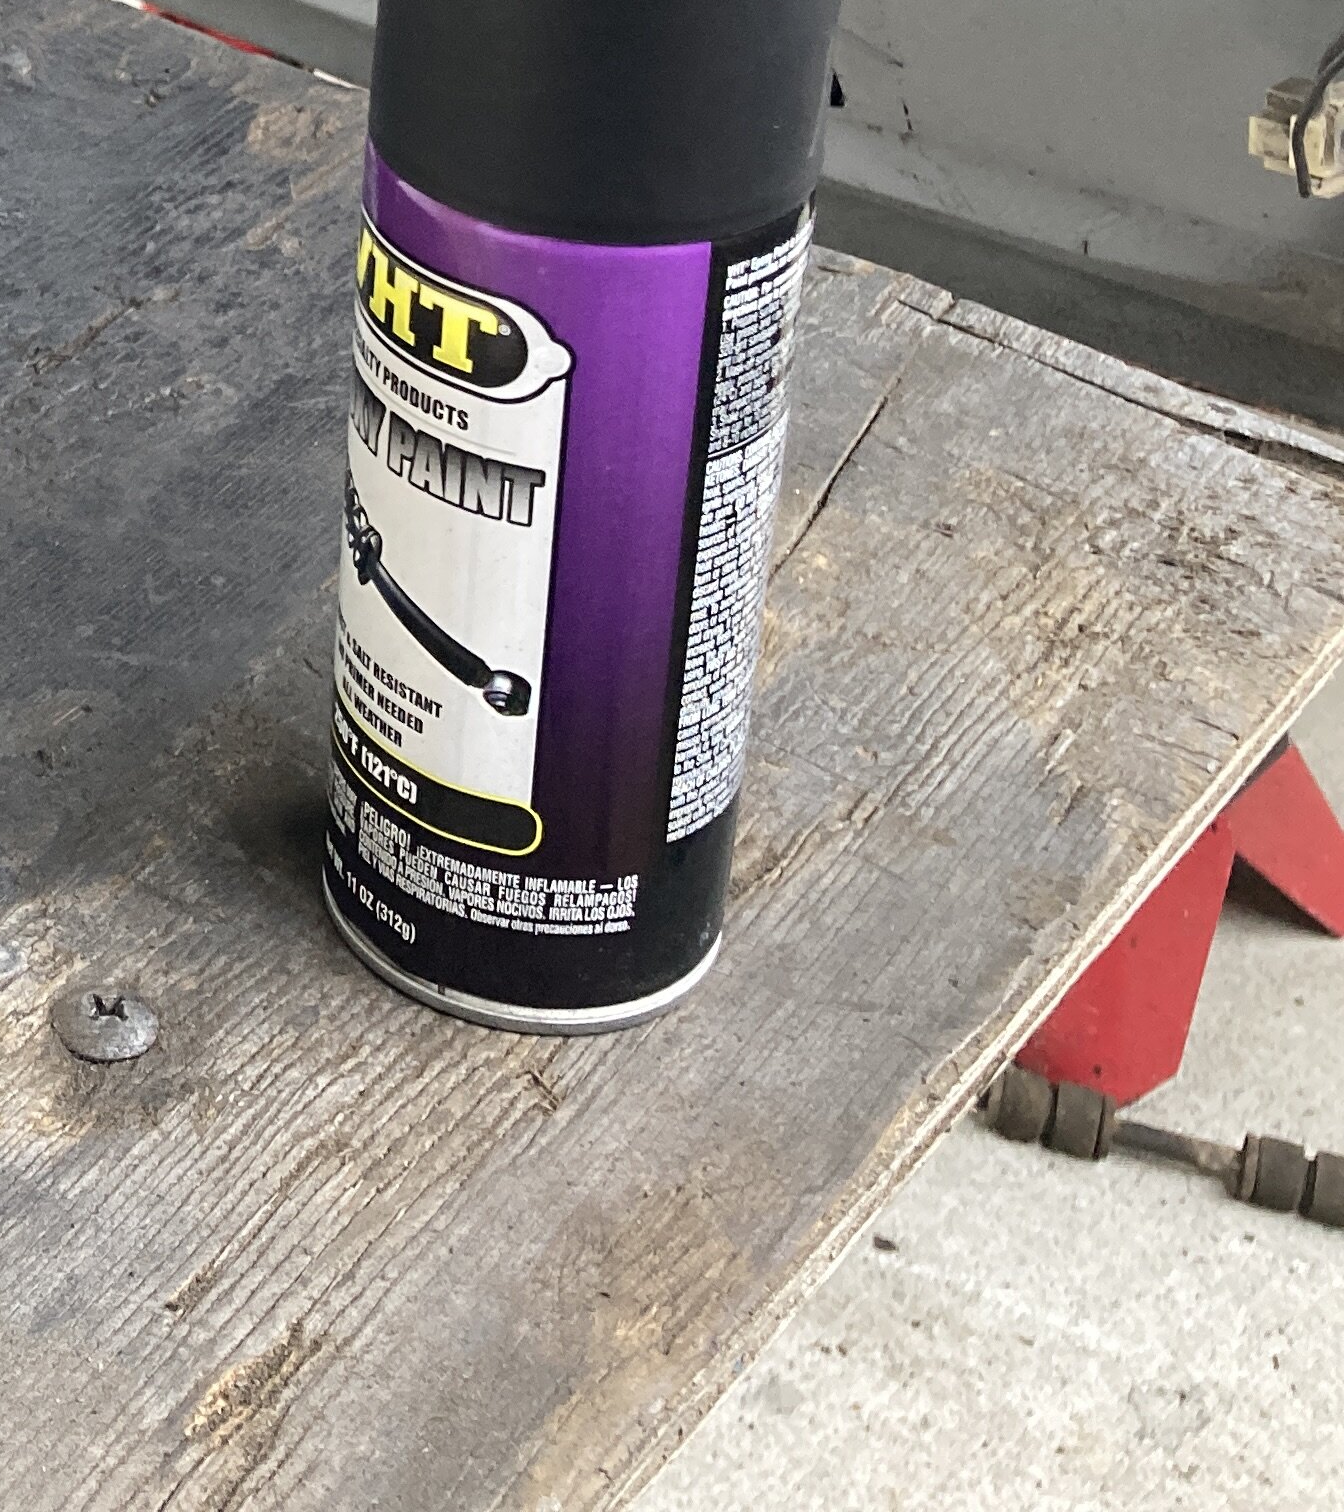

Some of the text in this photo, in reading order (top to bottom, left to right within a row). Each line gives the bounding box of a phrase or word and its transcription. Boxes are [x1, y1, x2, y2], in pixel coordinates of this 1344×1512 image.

[383, 365, 470, 432] PRODUCTS
[387, 410, 547, 528] PAINT
[354, 692, 403, 748] WEATHER
[373, 661, 443, 719] RESISTANT
[377, 691, 424, 734] NEEDED
[395, 873, 469, 919] RESPIRATORIAS.
[470, 908, 511, 929] Observar
[510, 917, 534, 933] otras
[534, 921, 594, 936] precauciones
[594, 921, 604, 935] al
[397, 861, 404, 875] A
[448, 886, 495, 912] VAPORES
[496, 899, 547, 920] NOCIVOS.
[549, 906, 583, 922] IRRITA
[584, 906, 606, 922] LOS
[606, 902, 636, 920] OJOS.
[399, 846, 438, 880] PUEDEN
[444, 871, 491, 897] CAUSAR
[498, 886, 546, 907] FUEGOS
[553, 889, 637, 908] RELAMPAGOS!
[524, 876, 597, 895] INFLAMABLE
[617, 874, 639, 892] LOS
[346, 871, 358, 895] 11
[359, 884, 375, 912] OZ
[375, 899, 417, 945] (312g)
